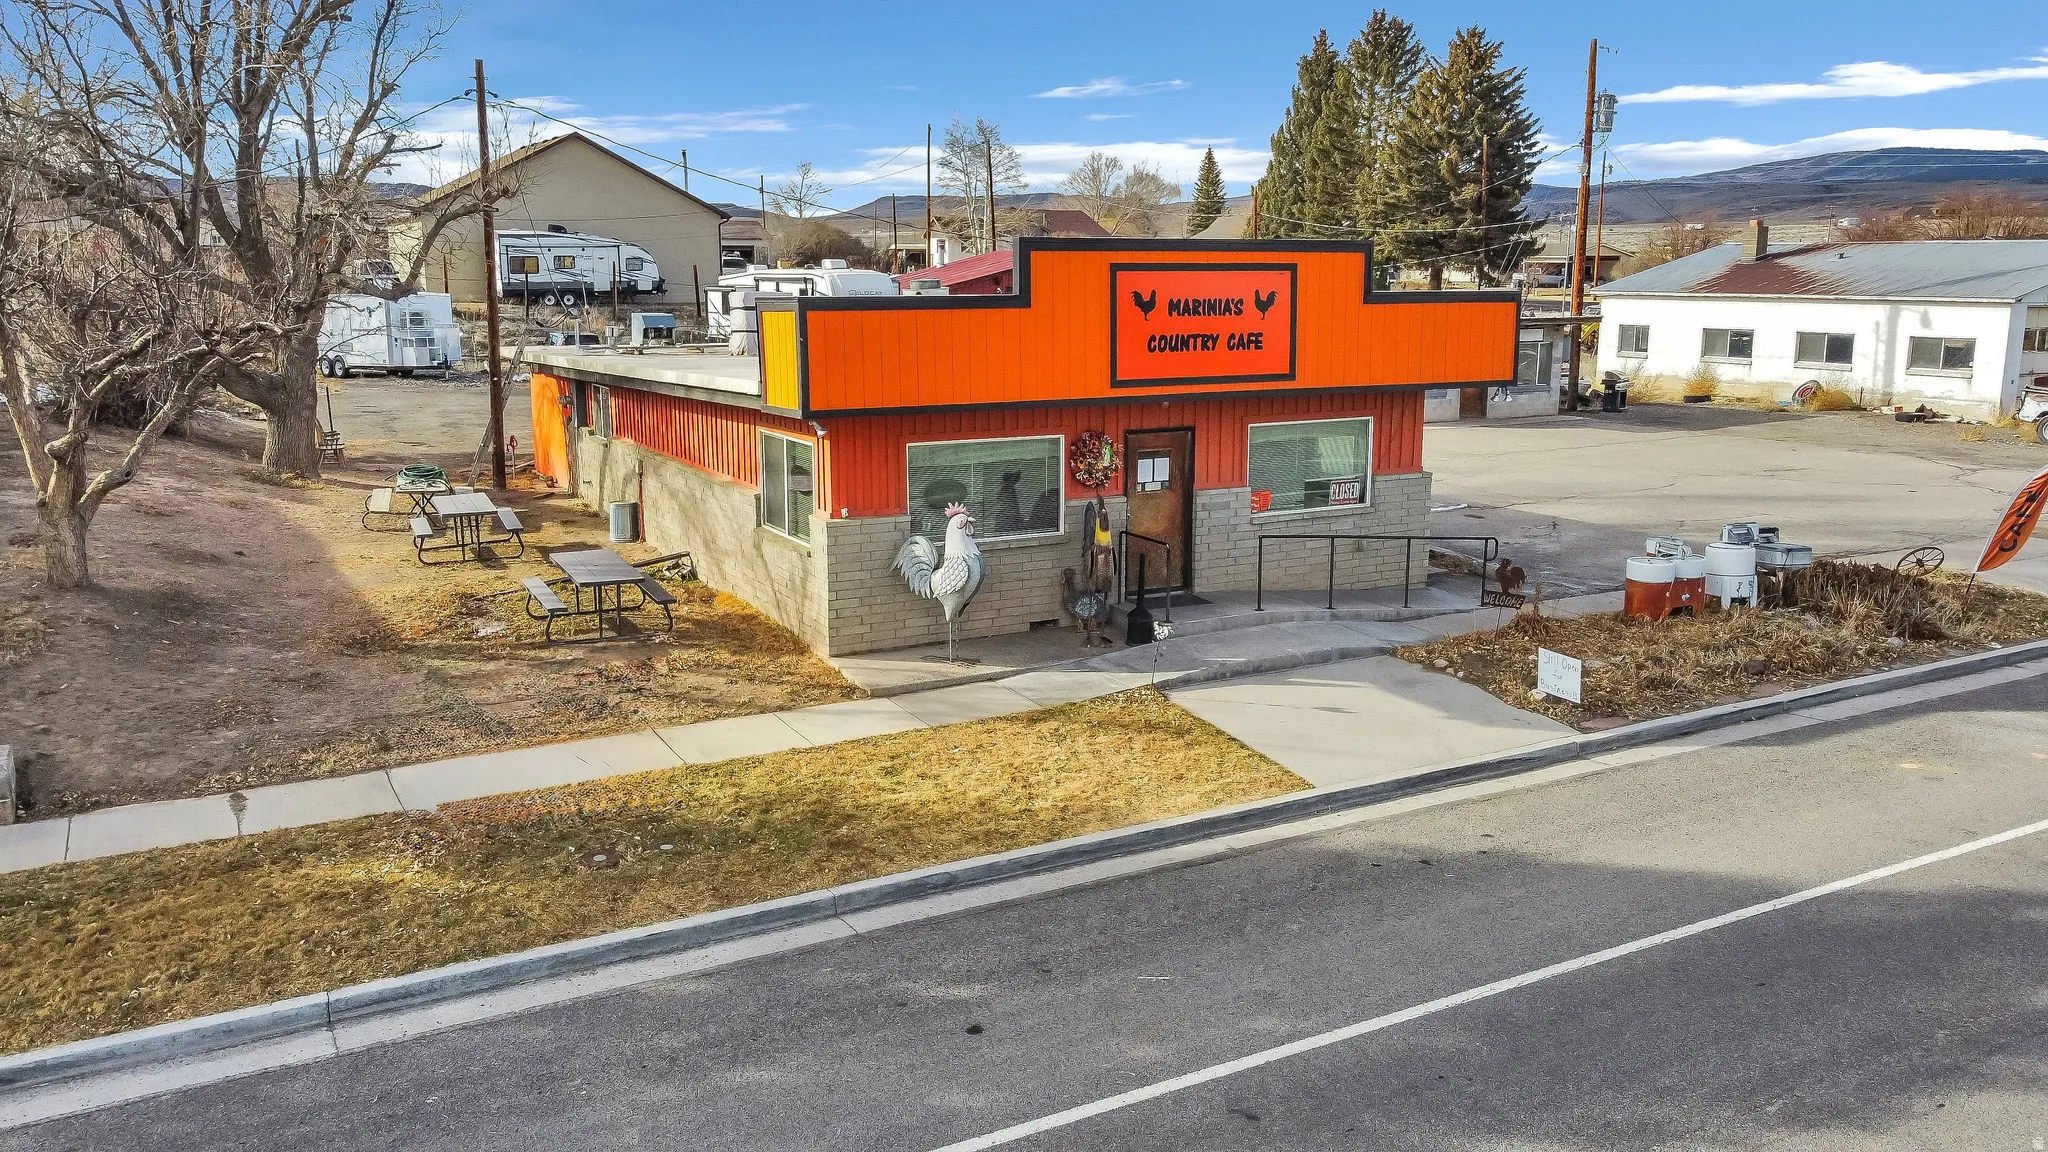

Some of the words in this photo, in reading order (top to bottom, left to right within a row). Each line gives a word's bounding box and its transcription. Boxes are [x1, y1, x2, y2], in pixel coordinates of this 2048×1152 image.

[1168, 298, 1244, 317] MARINIA'S
[1147, 332, 1220, 353] COUNTRY
[1226, 331, 1264, 351] CAFE
[1330, 482, 1359, 500] CLOSED
[1999, 488, 2044, 552] CAFE
[1483, 593, 1524, 608] WELCOME
[1543, 651, 1559, 668] Still
[1561, 657, 1579, 673] Open
